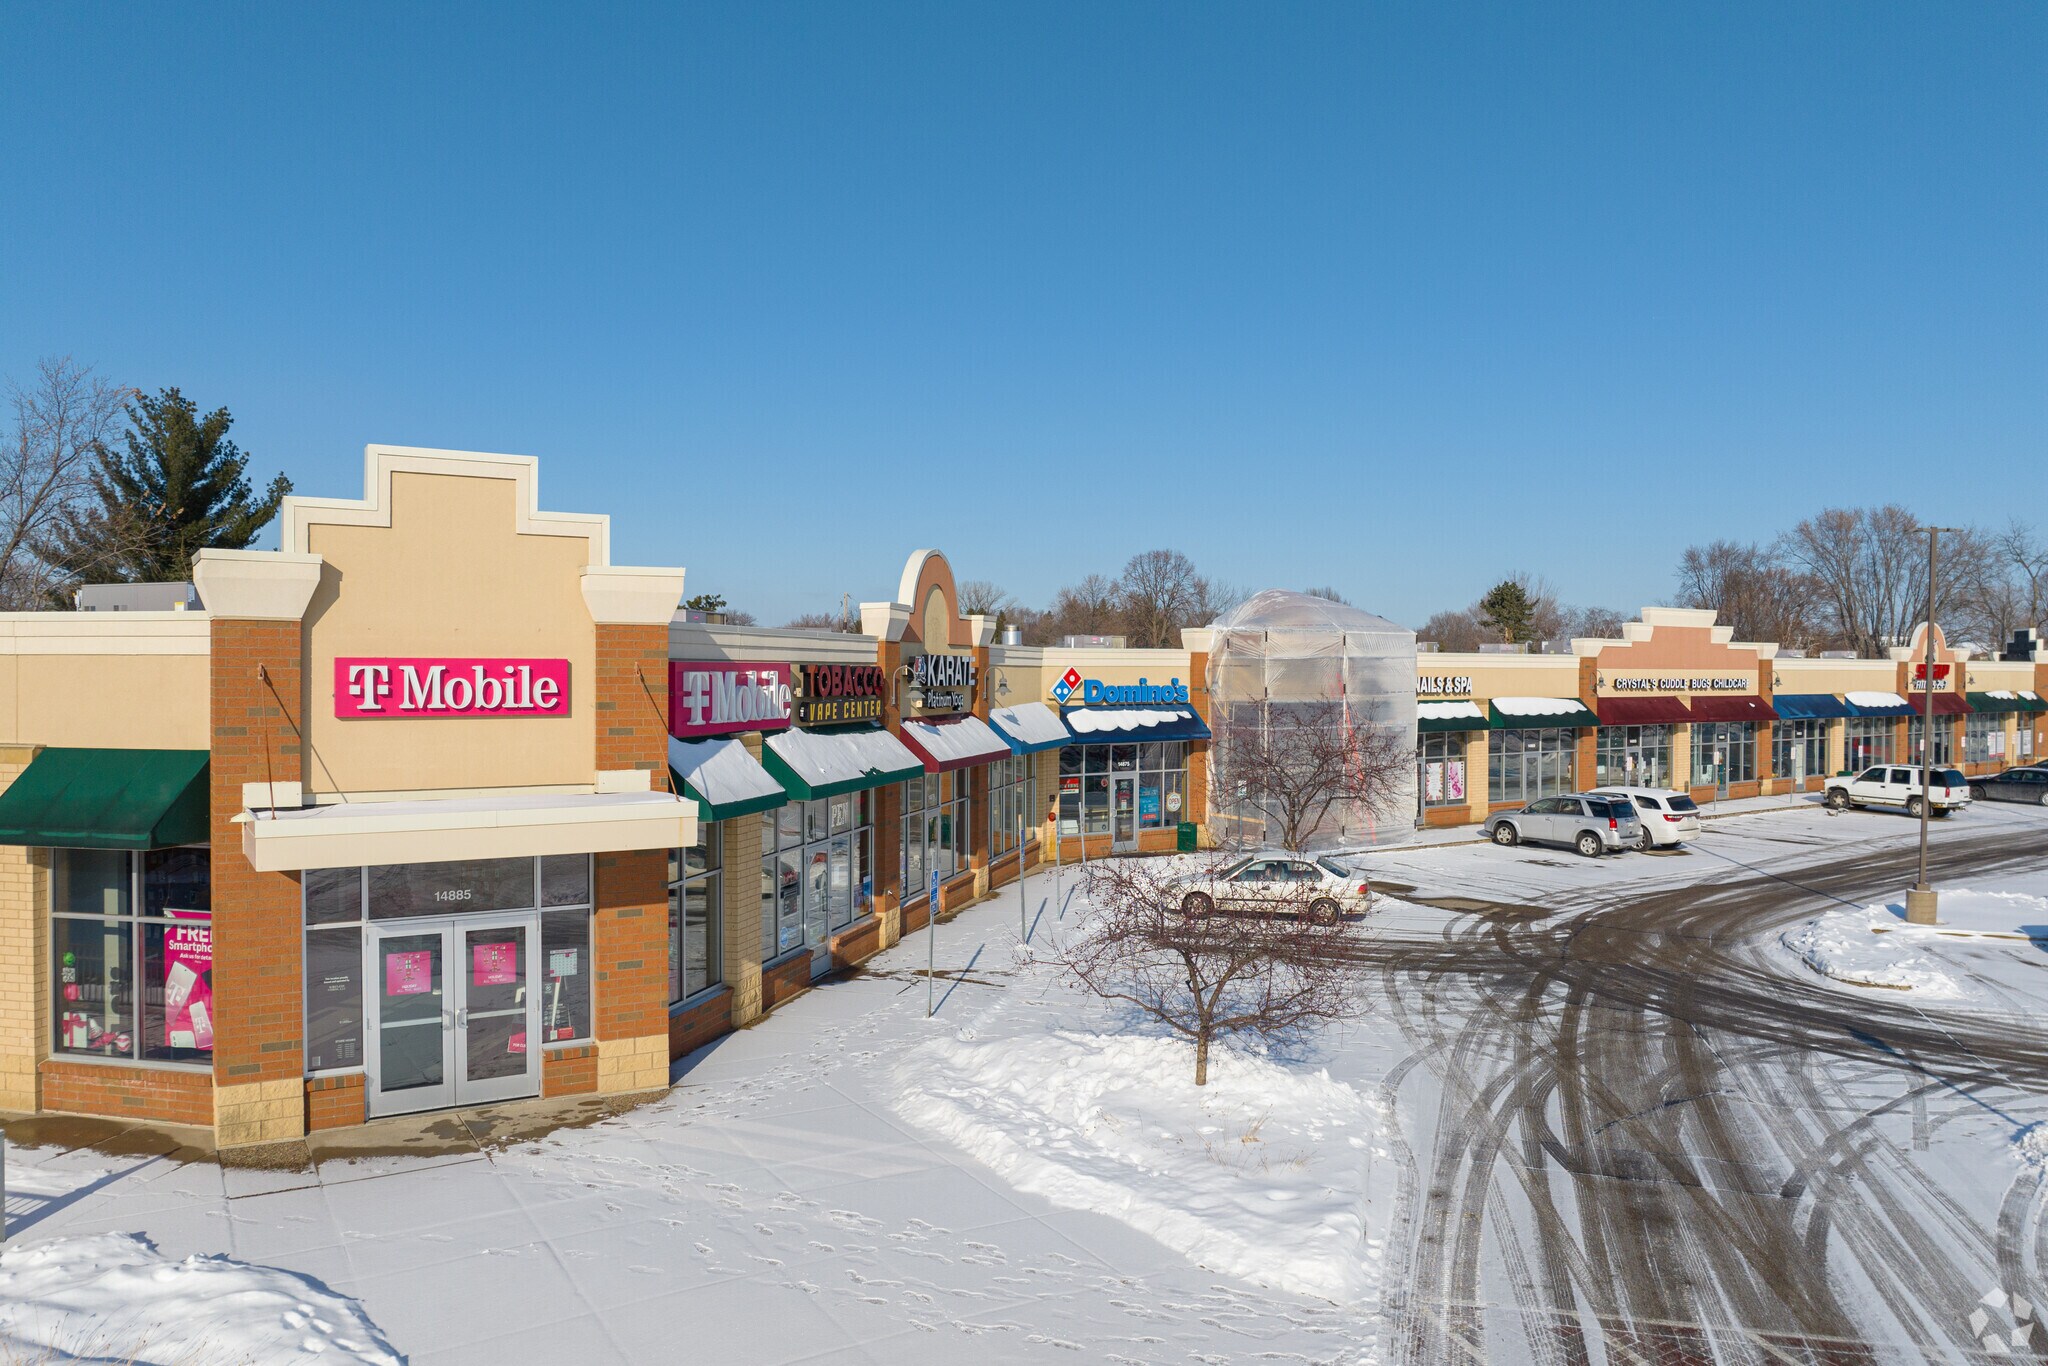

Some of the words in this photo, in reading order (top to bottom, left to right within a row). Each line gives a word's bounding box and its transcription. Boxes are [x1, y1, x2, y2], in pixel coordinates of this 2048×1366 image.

[803, 664, 885, 698] TOBACCO
[928, 654, 976, 687] KARATE
[398, 665, 558, 709] Mobile
[1084, 677, 1188, 704] Domino's
[1444, 676, 1453, 693] &
[1454, 676, 1472, 693] SPA
[1616, 678, 1656, 689] CRYSTAL'S
[1660, 678, 1688, 689] CUDDLE
[1692, 678, 1710, 688] BUGS
[1713, 678, 1749, 688] CHILDCARE
[710, 671, 791, 723] Mobile
[927, 689, 951, 708] Platinum
[952, 691, 964, 711] Yoga
[809, 702, 837, 721] VAPE
[843, 700, 881, 719] CENTER
[434, 889, 471, 901] 14885
[176, 925, 212, 942] FRE
